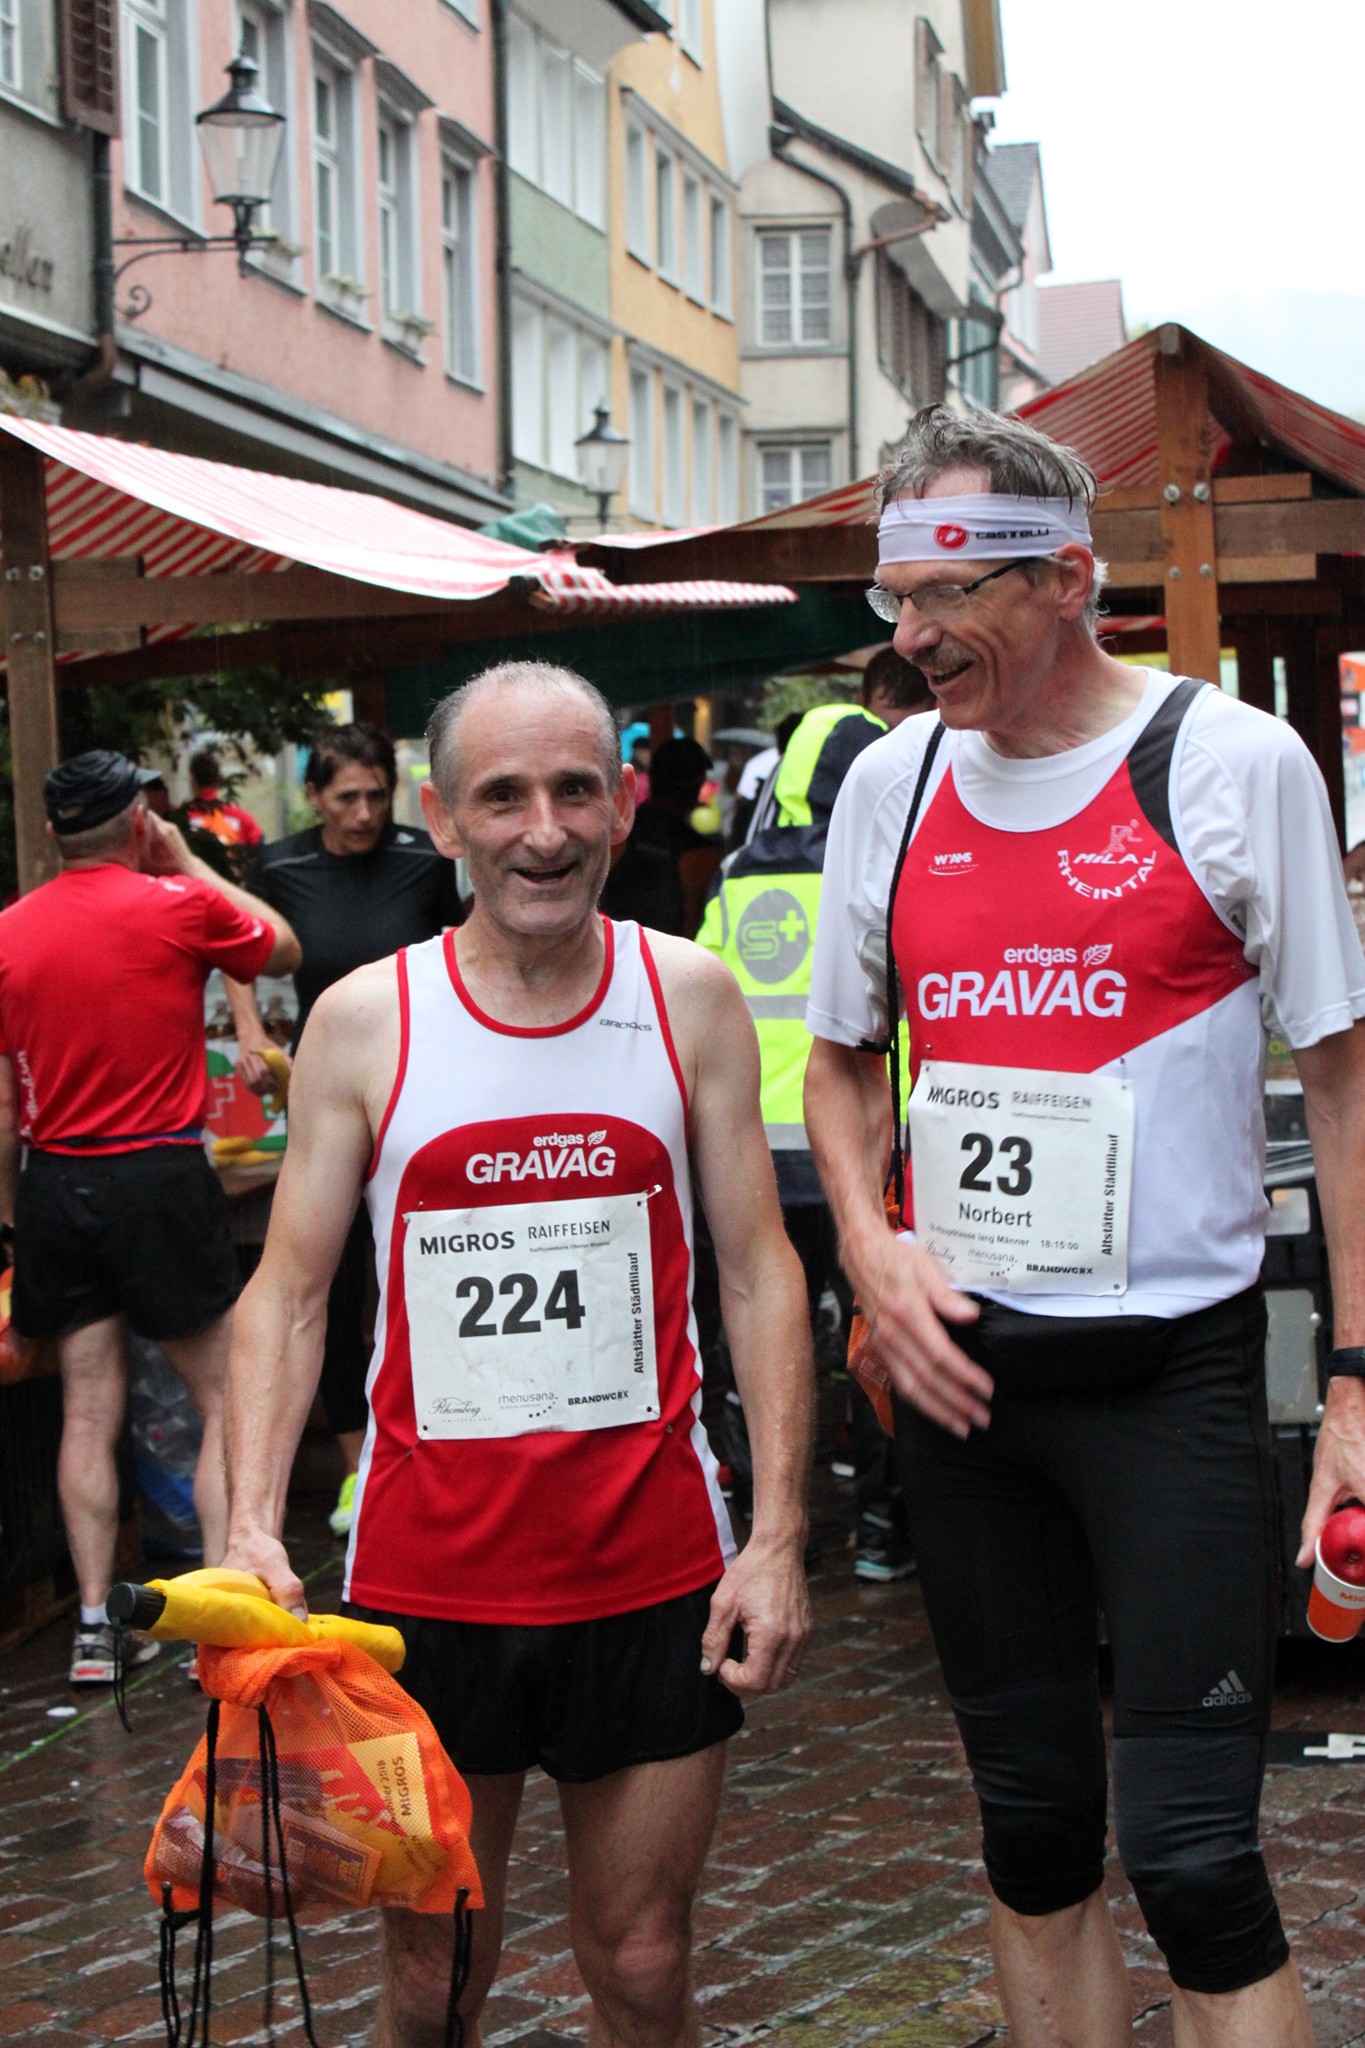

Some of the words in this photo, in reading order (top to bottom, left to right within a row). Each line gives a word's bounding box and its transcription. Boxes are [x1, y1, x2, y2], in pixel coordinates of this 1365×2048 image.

[976, 528, 1050, 540] CASTELLI
[1057, 850, 1157, 899] RHEINTAL
[1004, 943, 1077, 967] erdgas
[917, 969, 1128, 1021] GRAVAG
[600, 1019, 652, 1031] BROOKS
[1011, 1091, 1093, 1109] RAIFFEISEN
[533, 1132, 585, 1147] erdgas
[465, 1146, 617, 1184] GRAVAG
[960, 1132, 1033, 1197] 23
[958, 1202, 1033, 1228] Norbert
[419, 1230, 516, 1255] MIGROS
[528, 1220, 610, 1239] RAIFFEISEN
[996, 1234, 1030, 1247] Männer
[1040, 1238, 1079, 1251] 18:15:00
[627, 1252, 642, 1315] Städtlilauf
[456, 1269, 586, 1338] 224
[633, 1318, 644, 1374] Altstätter
[498, 1391, 555, 1404] rhenusana
[1202, 1692, 1253, 1707] adidas
[392, 1756, 412, 1817] MIGROS
